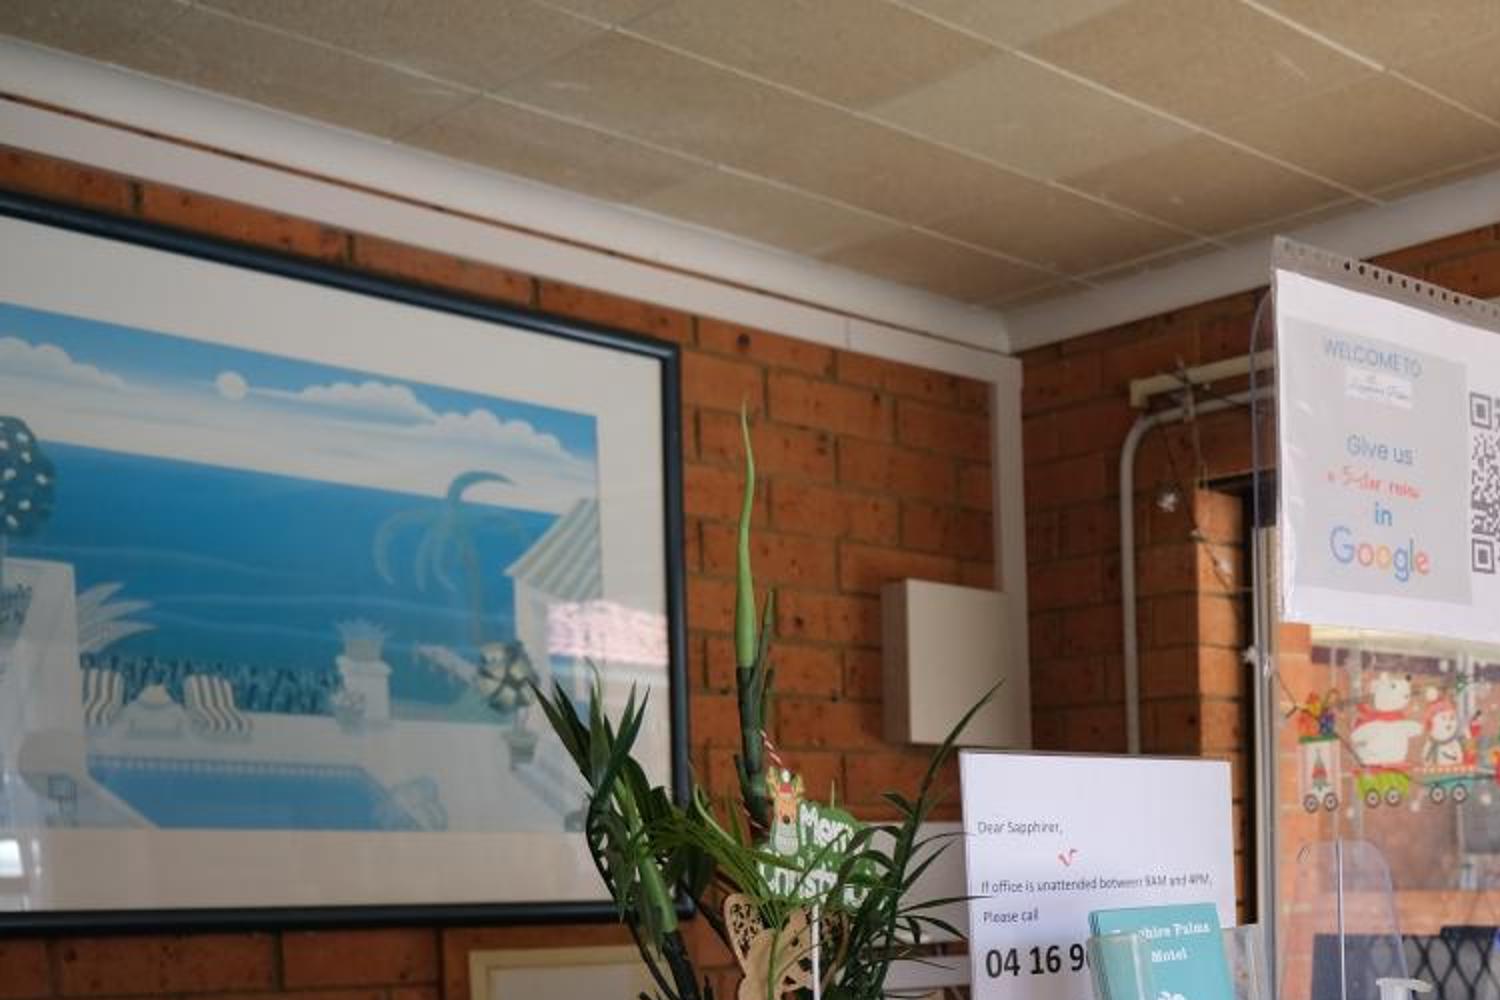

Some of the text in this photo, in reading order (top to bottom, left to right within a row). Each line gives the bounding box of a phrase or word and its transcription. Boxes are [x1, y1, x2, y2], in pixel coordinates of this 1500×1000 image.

[1322, 335, 1423, 379] WELCOME TO
[1347, 433, 1413, 465] Give us
[1375, 501, 1393, 527] in
[1330, 525, 1430, 582] Google
[978, 821, 1005, 834] Dear
[992, 879, 1024, 893] office
[1025, 879, 1035, 892] is
[1038, 876, 1097, 891] unattended
[983, 906, 1039, 923] Please call
[986, 943, 1091, 978] 04 16 9
[1151, 947, 1188, 962] Motel
